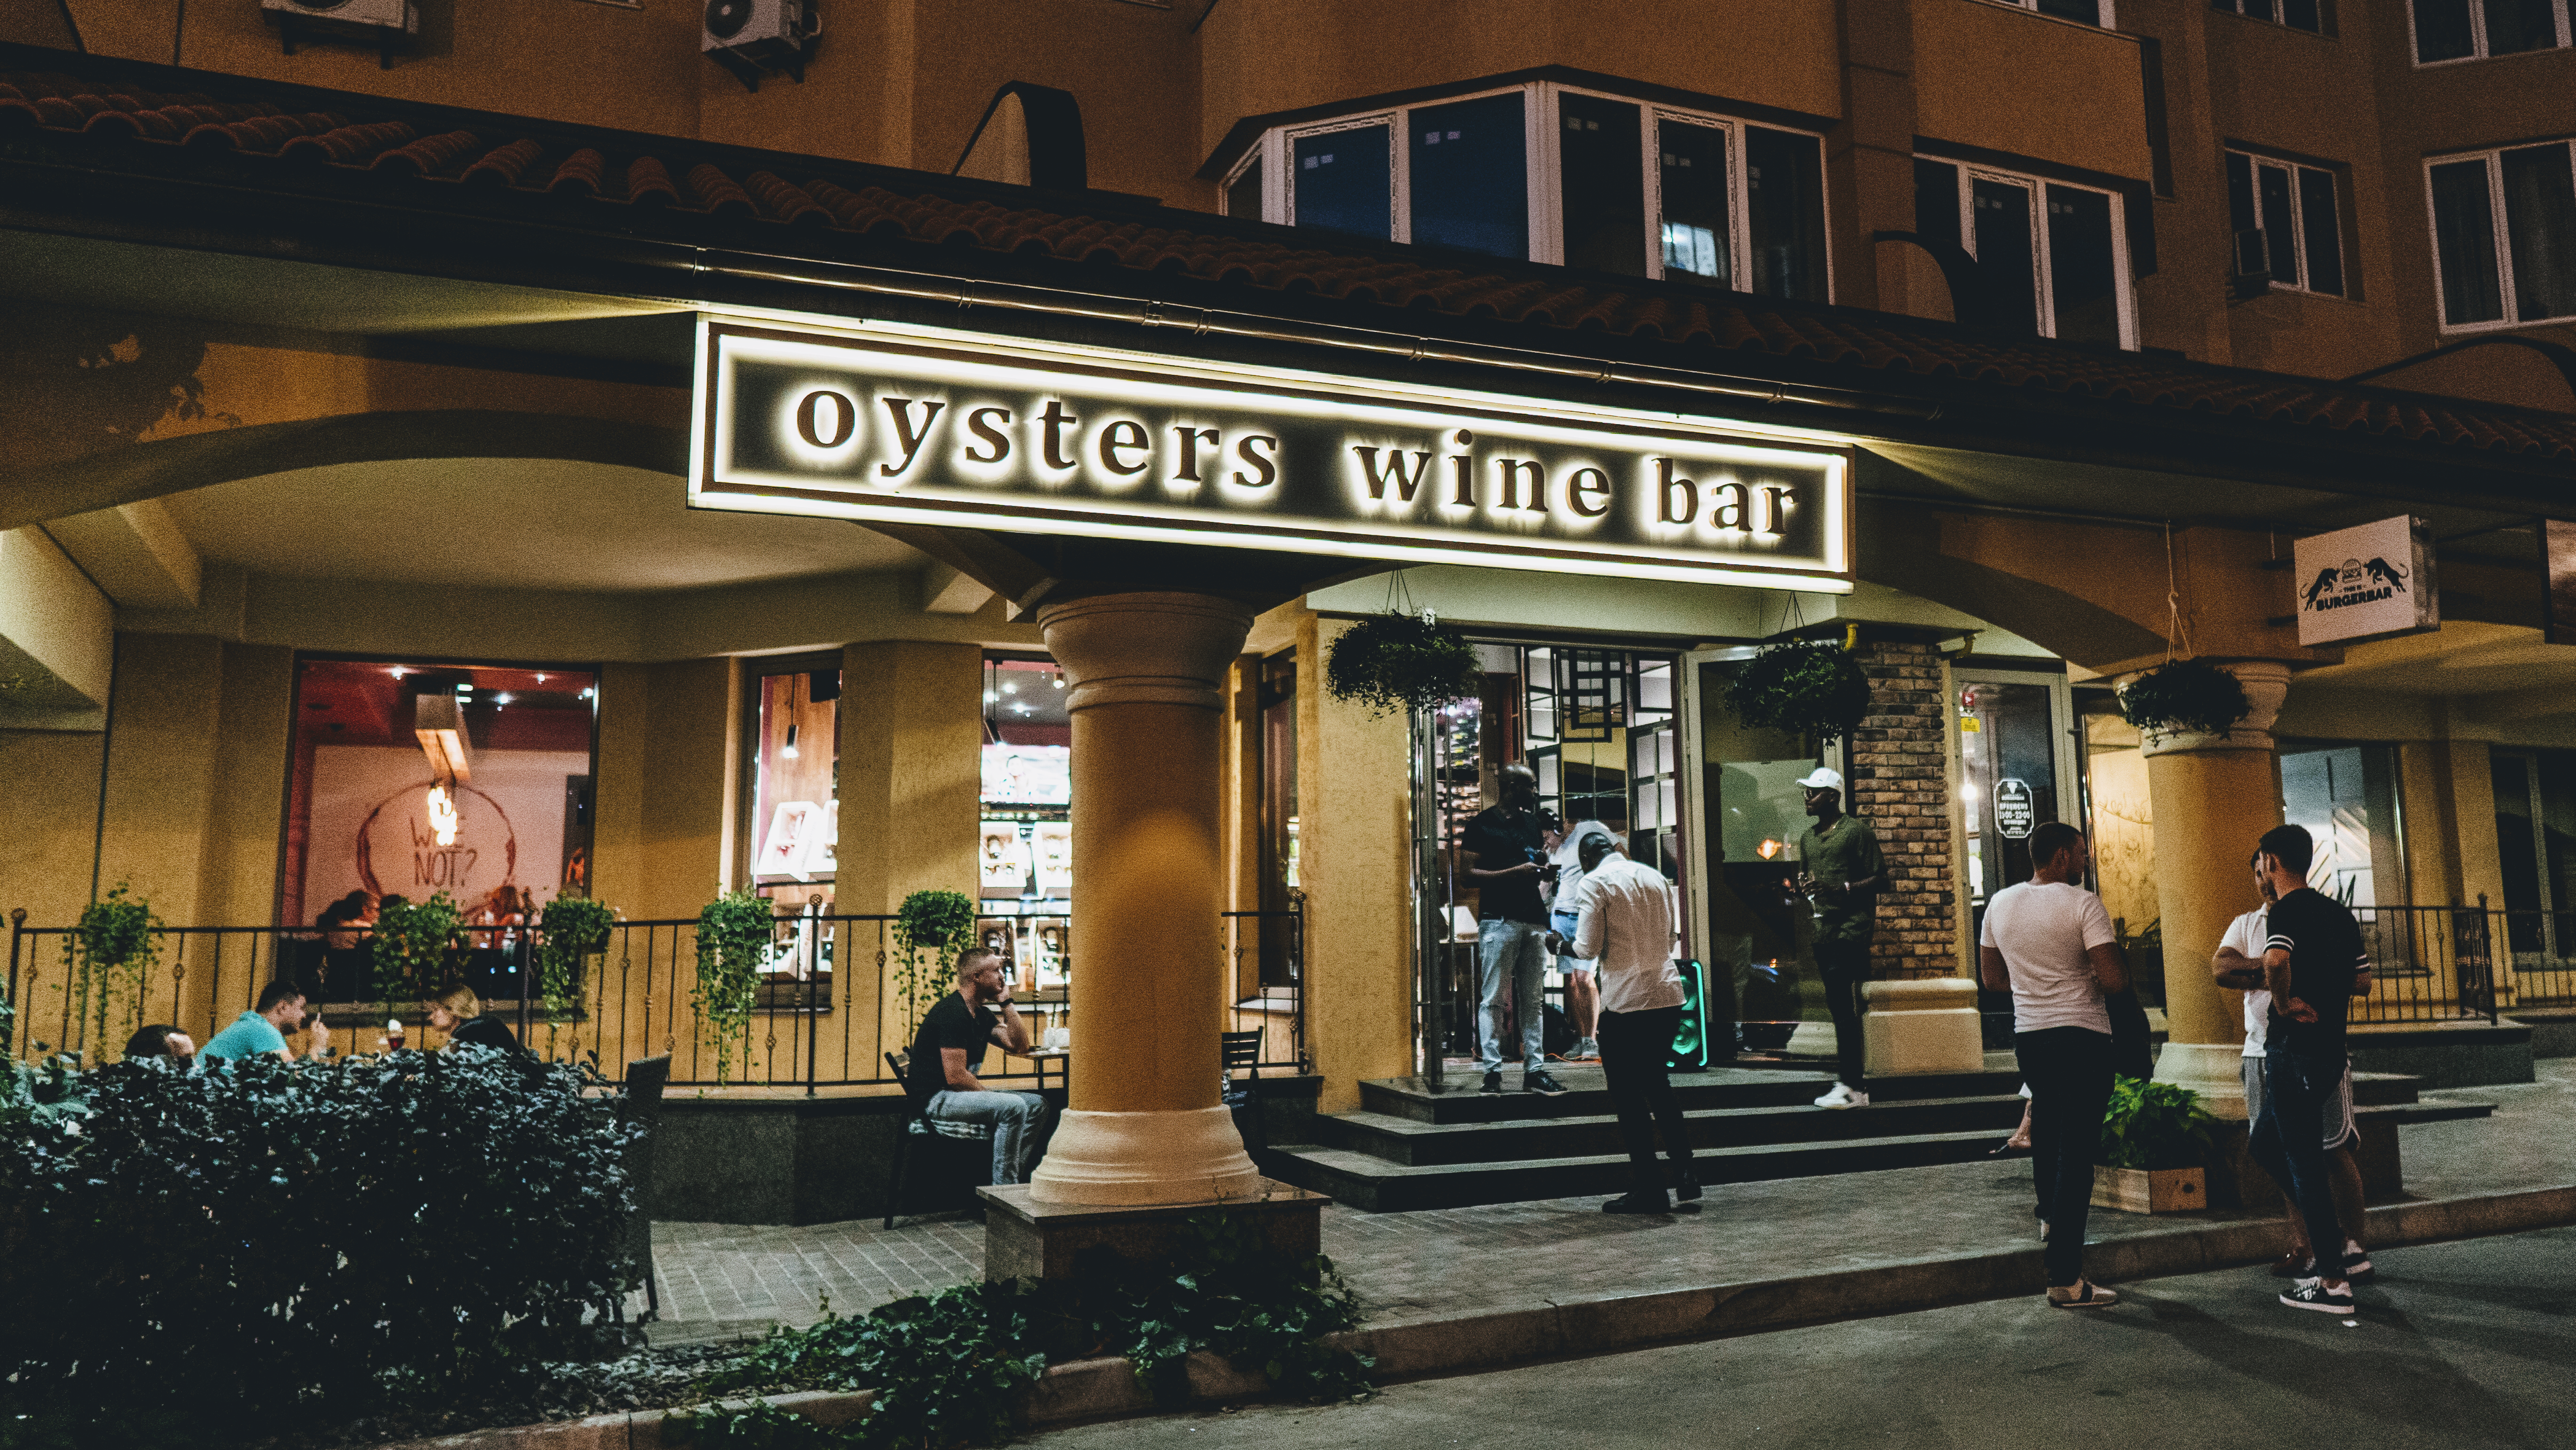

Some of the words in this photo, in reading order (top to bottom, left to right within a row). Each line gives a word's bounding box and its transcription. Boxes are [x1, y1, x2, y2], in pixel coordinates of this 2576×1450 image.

[796, 389, 1278, 487] oysters
[1352, 428, 1611, 518] wine
[1651, 456, 1798, 535] bar
[2316, 587, 2392, 612] BURGERBAR
[414, 849, 477, 888] NOT?
